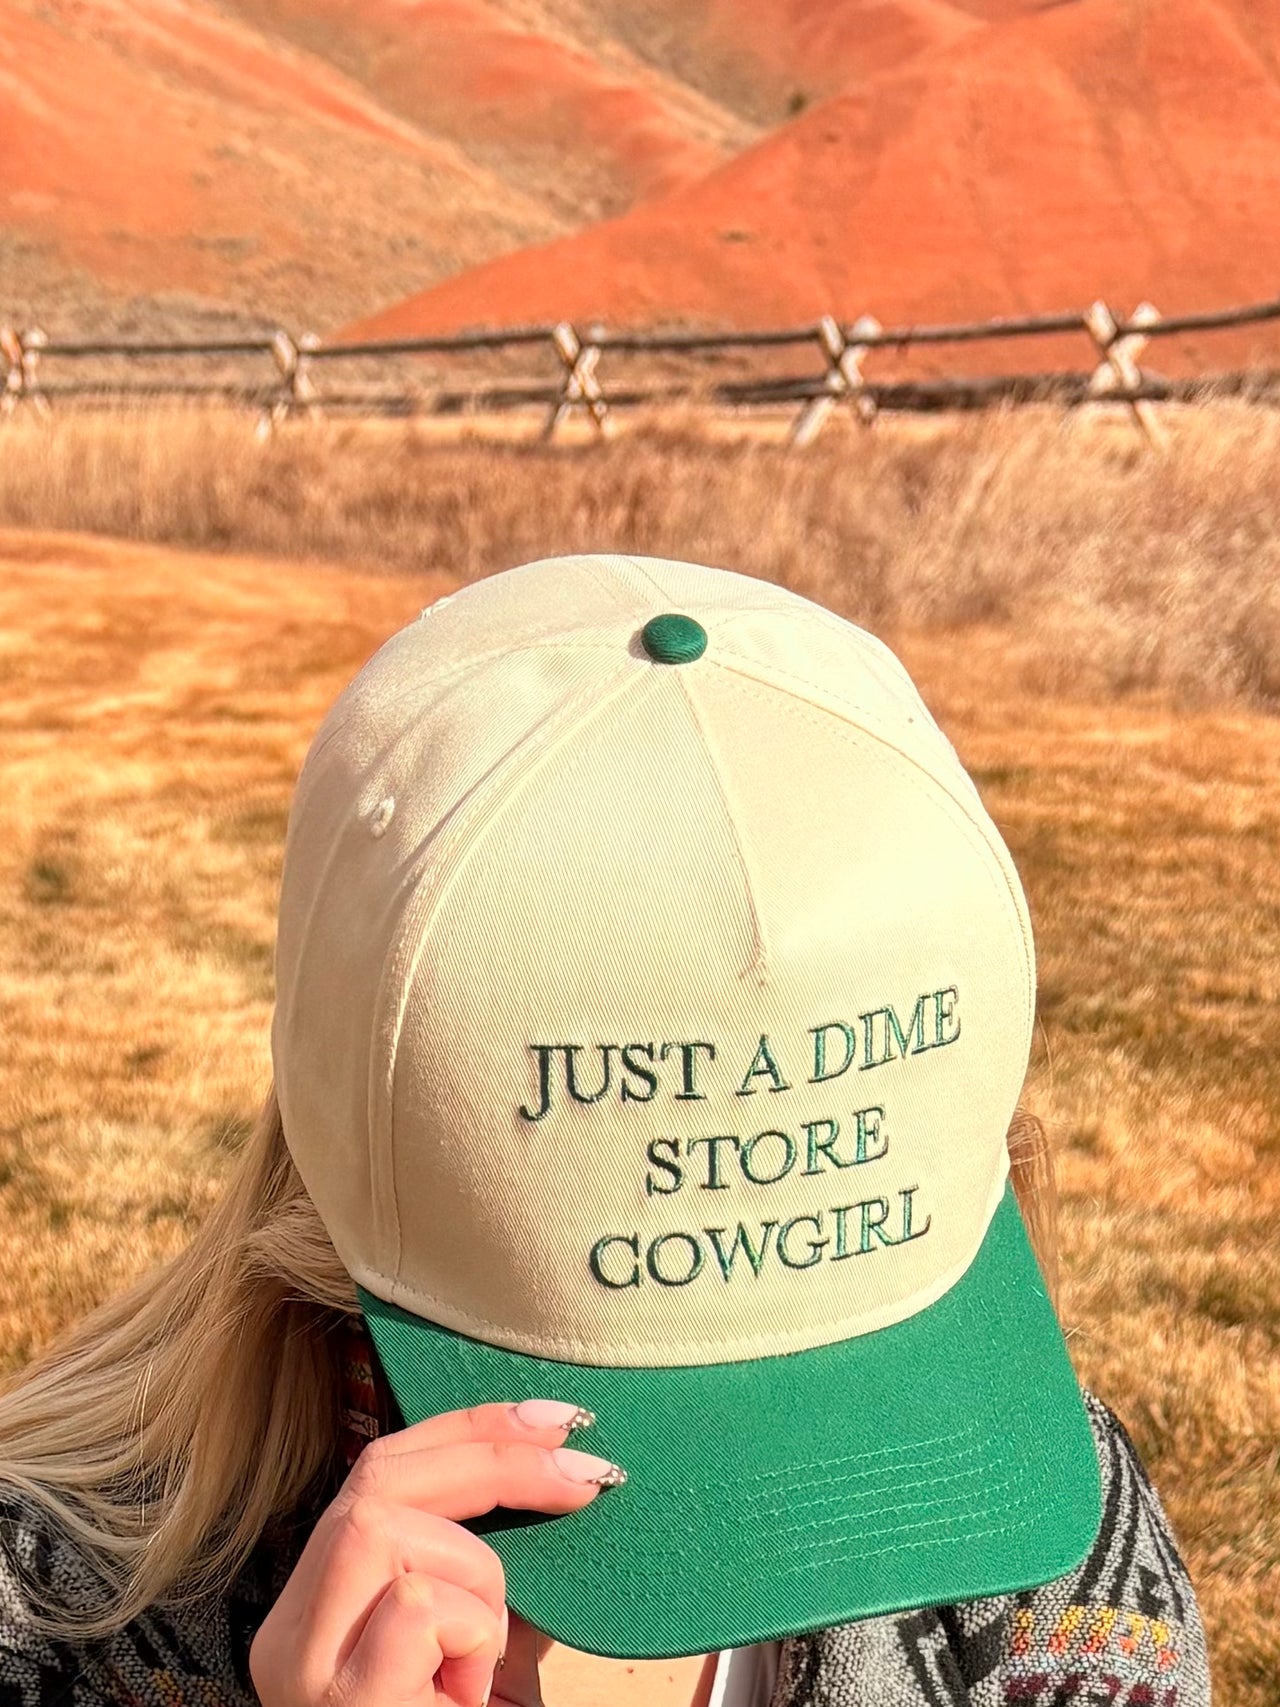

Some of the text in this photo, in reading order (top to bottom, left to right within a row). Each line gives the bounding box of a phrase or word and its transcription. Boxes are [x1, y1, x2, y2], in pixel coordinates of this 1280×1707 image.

[519, 985, 961, 1122] JUST A DIME
[646, 1104, 889, 1197] STORE
[589, 1185, 932, 1289] COWGIRL
